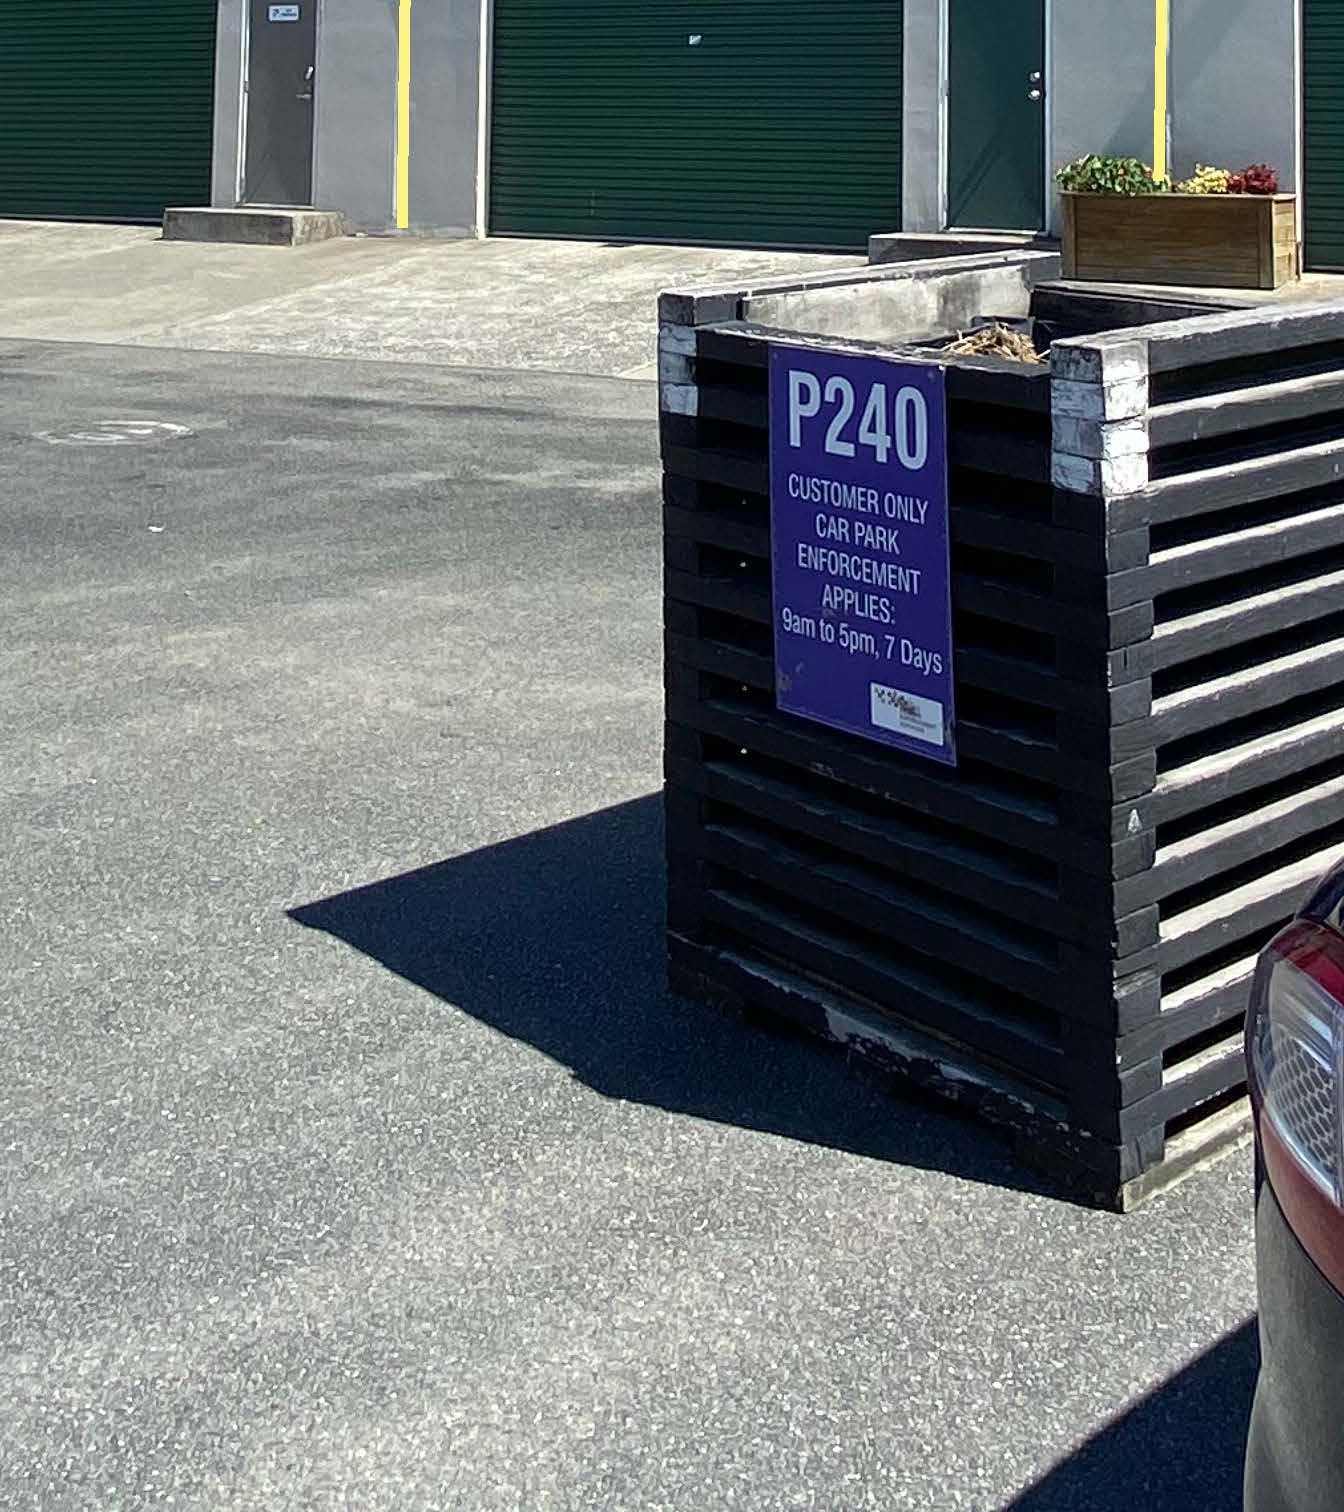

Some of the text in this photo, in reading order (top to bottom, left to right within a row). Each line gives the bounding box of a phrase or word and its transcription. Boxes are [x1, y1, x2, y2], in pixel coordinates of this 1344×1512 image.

[788, 370, 927, 470] P240
[788, 473, 928, 526] CUSTOMER ONLY
[816, 514, 900, 555] CAR PARK
[798, 543, 921, 594] ENFORCEMENT
[822, 584, 895, 625] APPLIES:
[782, 607, 943, 676] 9am to 5pm, 7 Days
